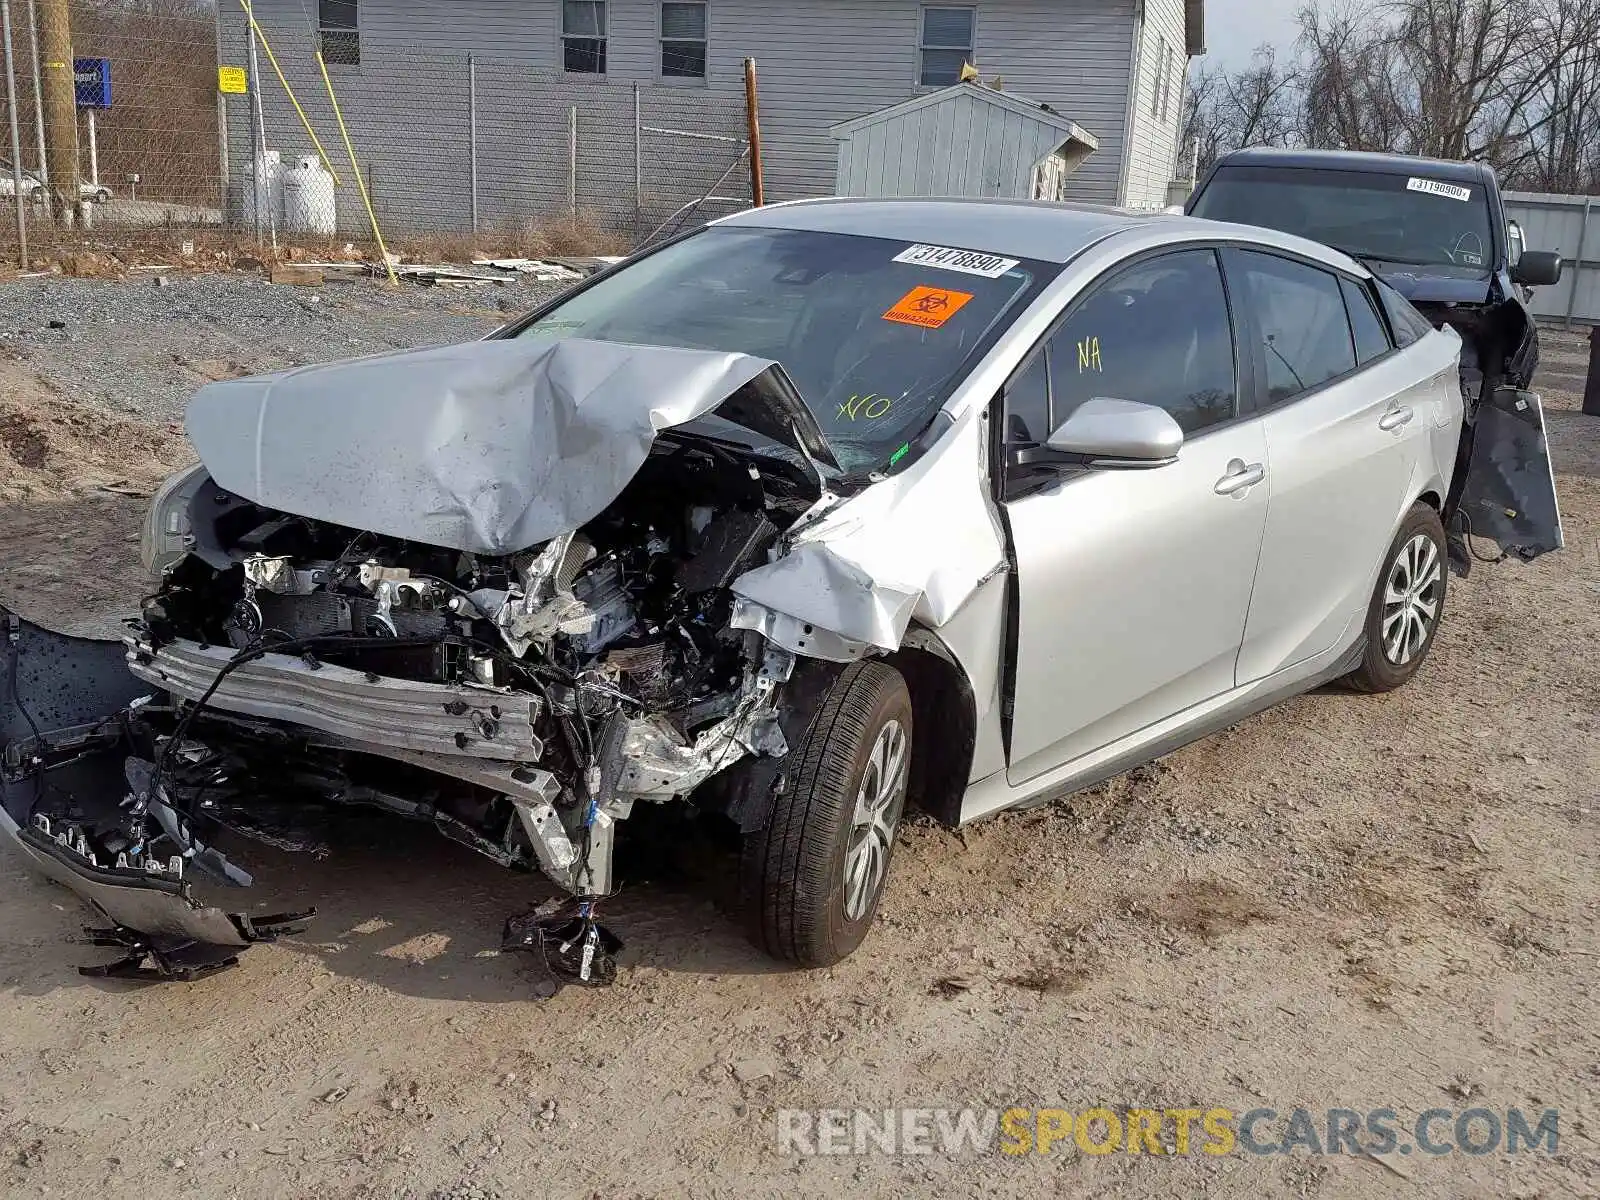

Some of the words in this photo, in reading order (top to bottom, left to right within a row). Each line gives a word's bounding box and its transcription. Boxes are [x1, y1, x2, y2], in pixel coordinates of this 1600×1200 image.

[75, 72, 97, 82] opart
[914, 247, 1003, 271] 31478890
[887, 311, 942, 326] BIOHAZARD
[1077, 335, 1102, 374] NA
[835, 393, 891, 421] NO
